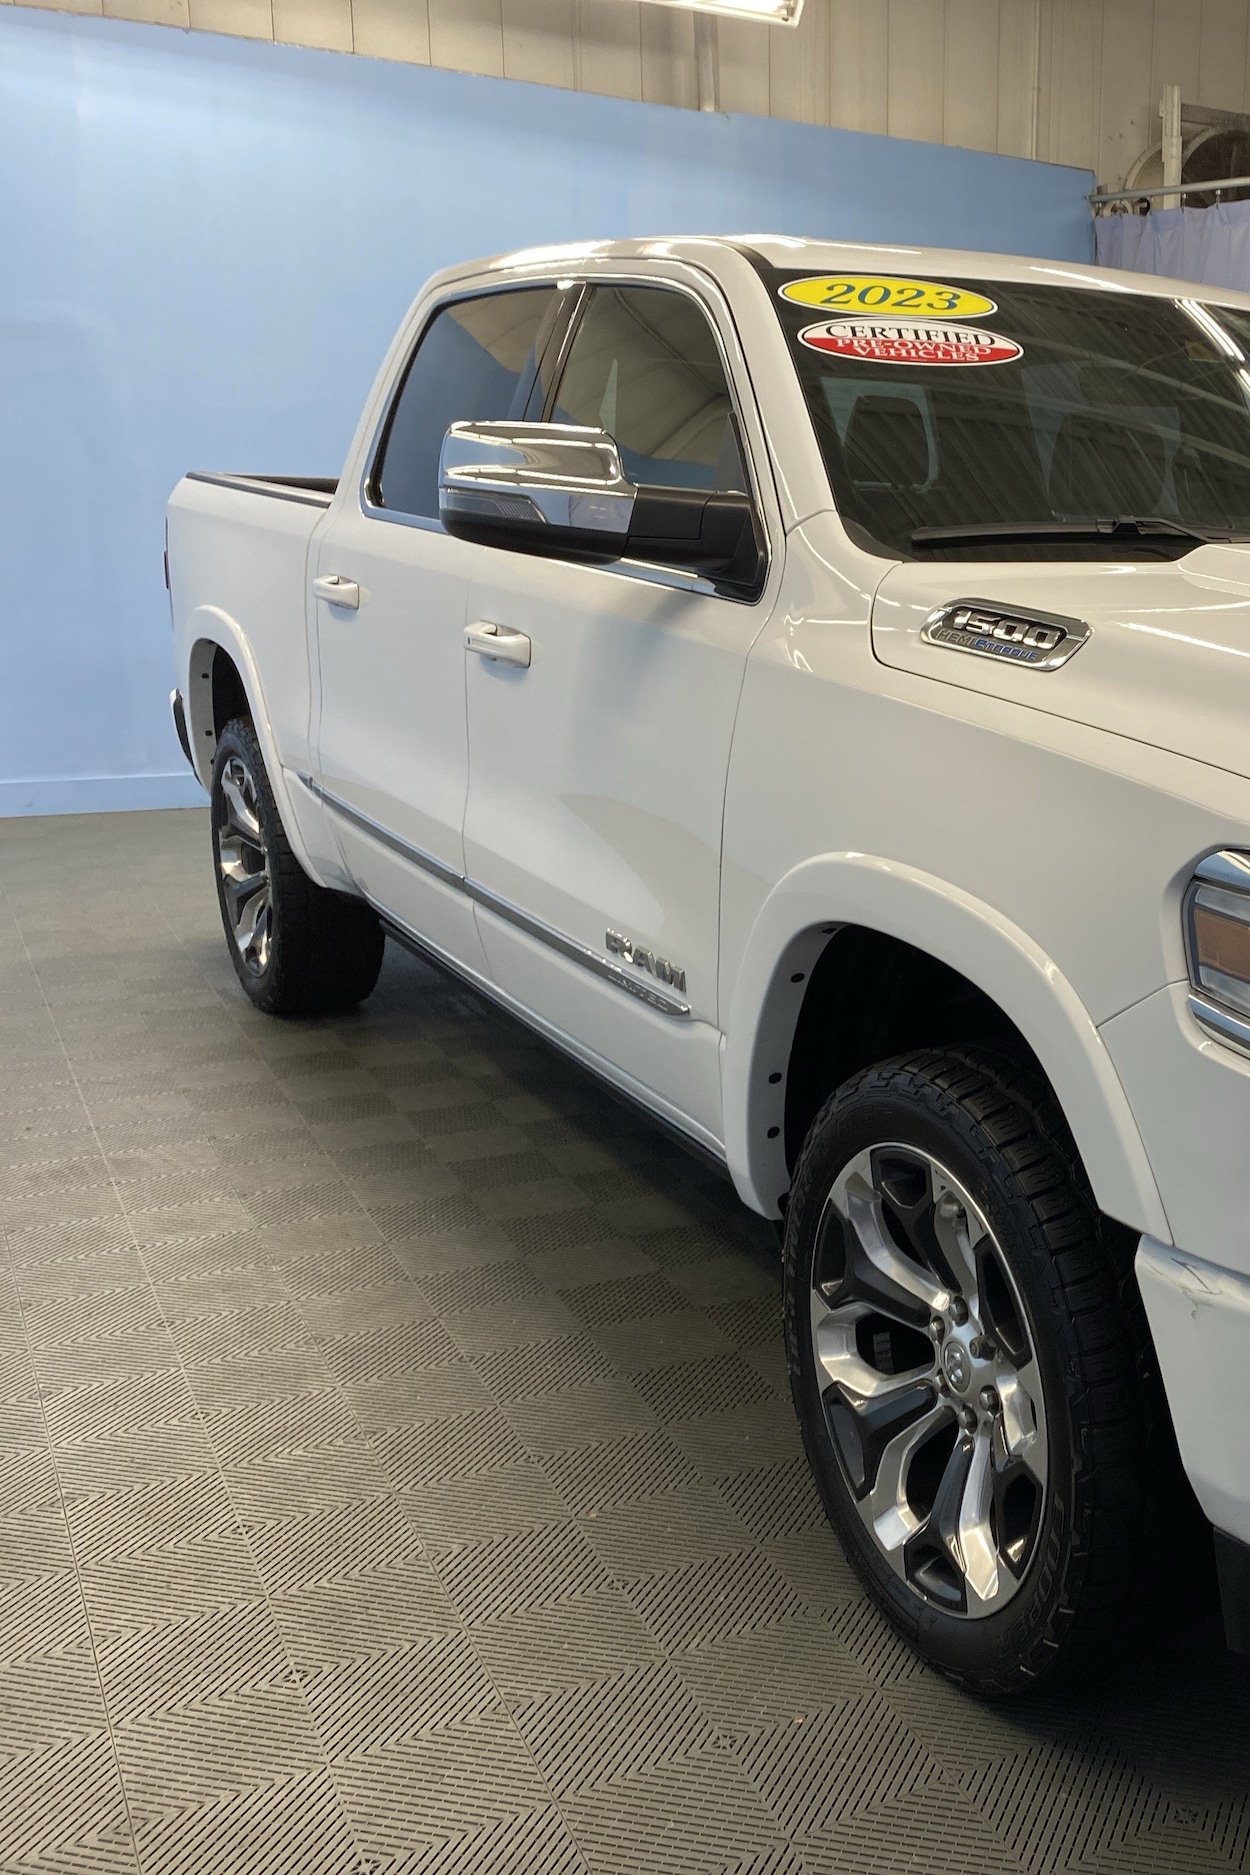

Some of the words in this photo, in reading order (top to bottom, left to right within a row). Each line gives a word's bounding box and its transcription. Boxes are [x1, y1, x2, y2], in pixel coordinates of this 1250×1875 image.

[819, 283, 961, 310] 2023
[825, 324, 996, 346] CERTIFIED
[837, 338, 992, 355] PRE-OWNED
[854, 346, 980, 362] VEHICLES
[952, 609, 1061, 650] 1500
[605, 927, 687, 993] RAM
